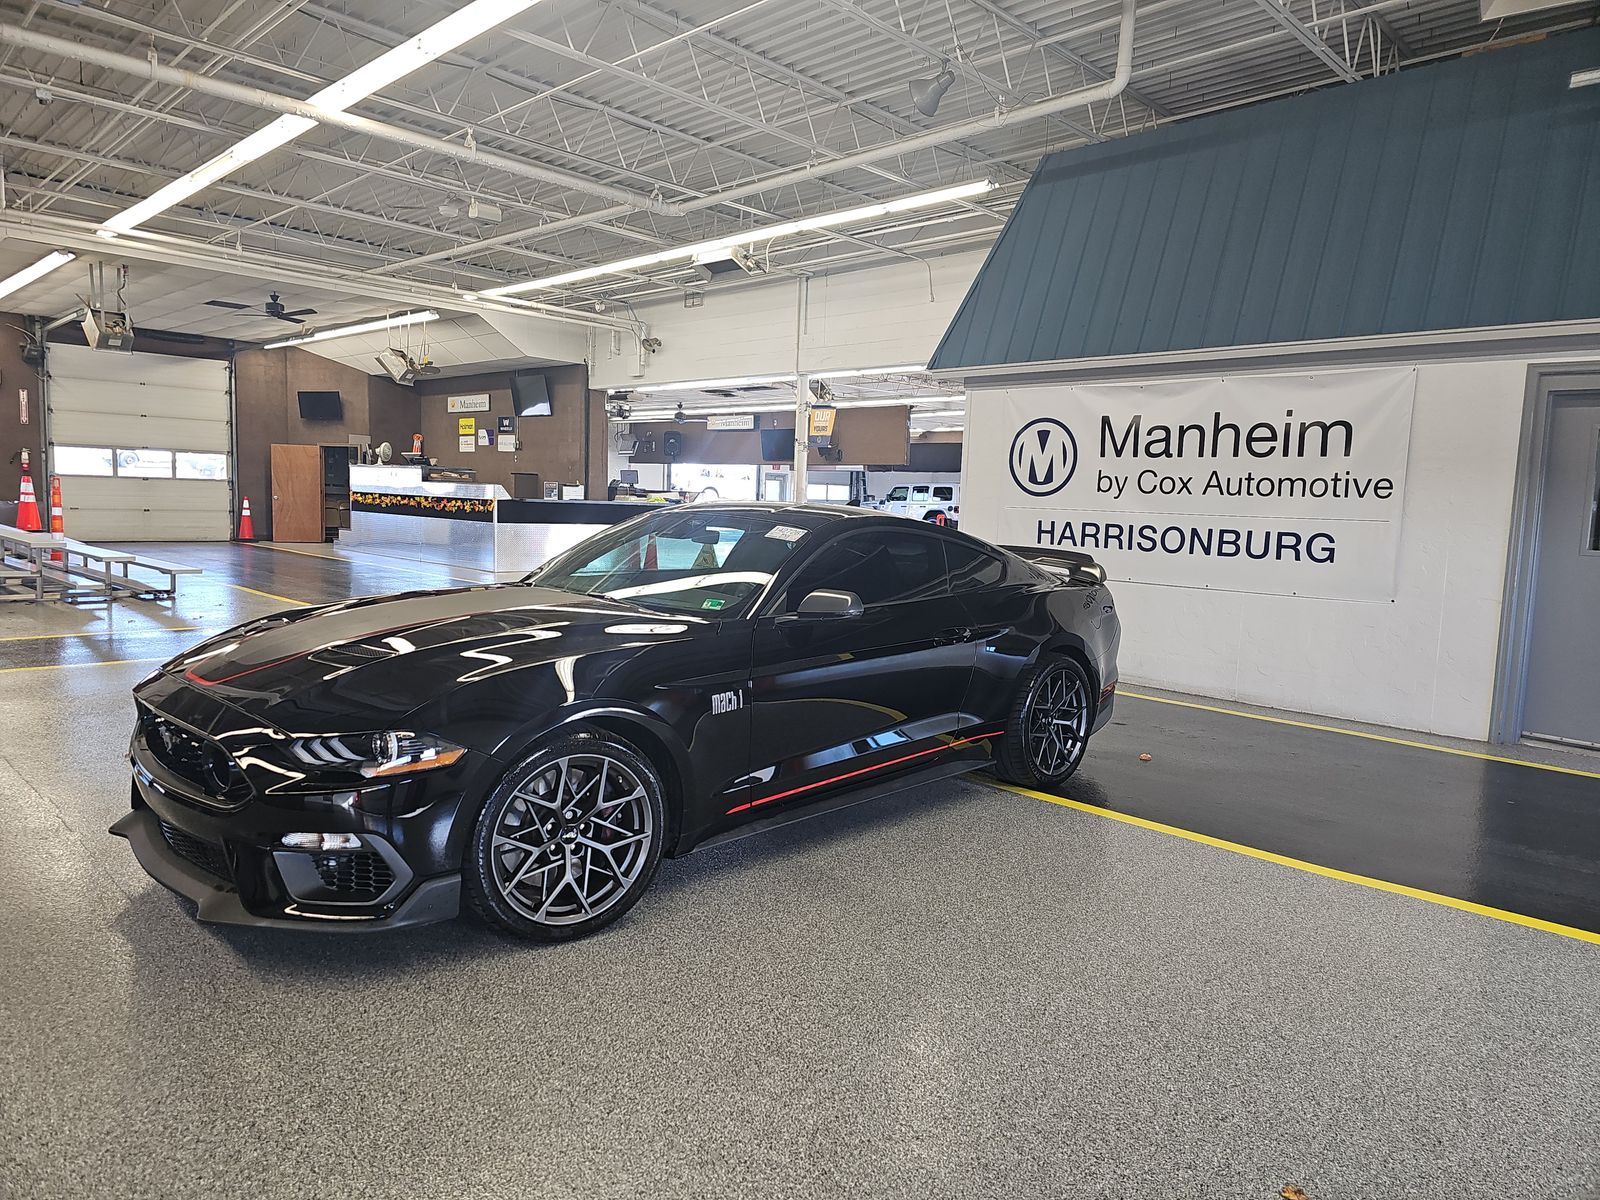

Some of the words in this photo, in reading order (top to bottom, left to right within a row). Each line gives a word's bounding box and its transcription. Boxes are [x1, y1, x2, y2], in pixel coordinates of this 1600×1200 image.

[459, 398, 487, 410] Manheim
[1099, 409, 1353, 459] Manheim
[1096, 469, 1129, 500] by
[1137, 469, 1193, 495] Cox
[1202, 470, 1394, 500] Automotive
[1036, 519, 1336, 564] HARRISONBURG
